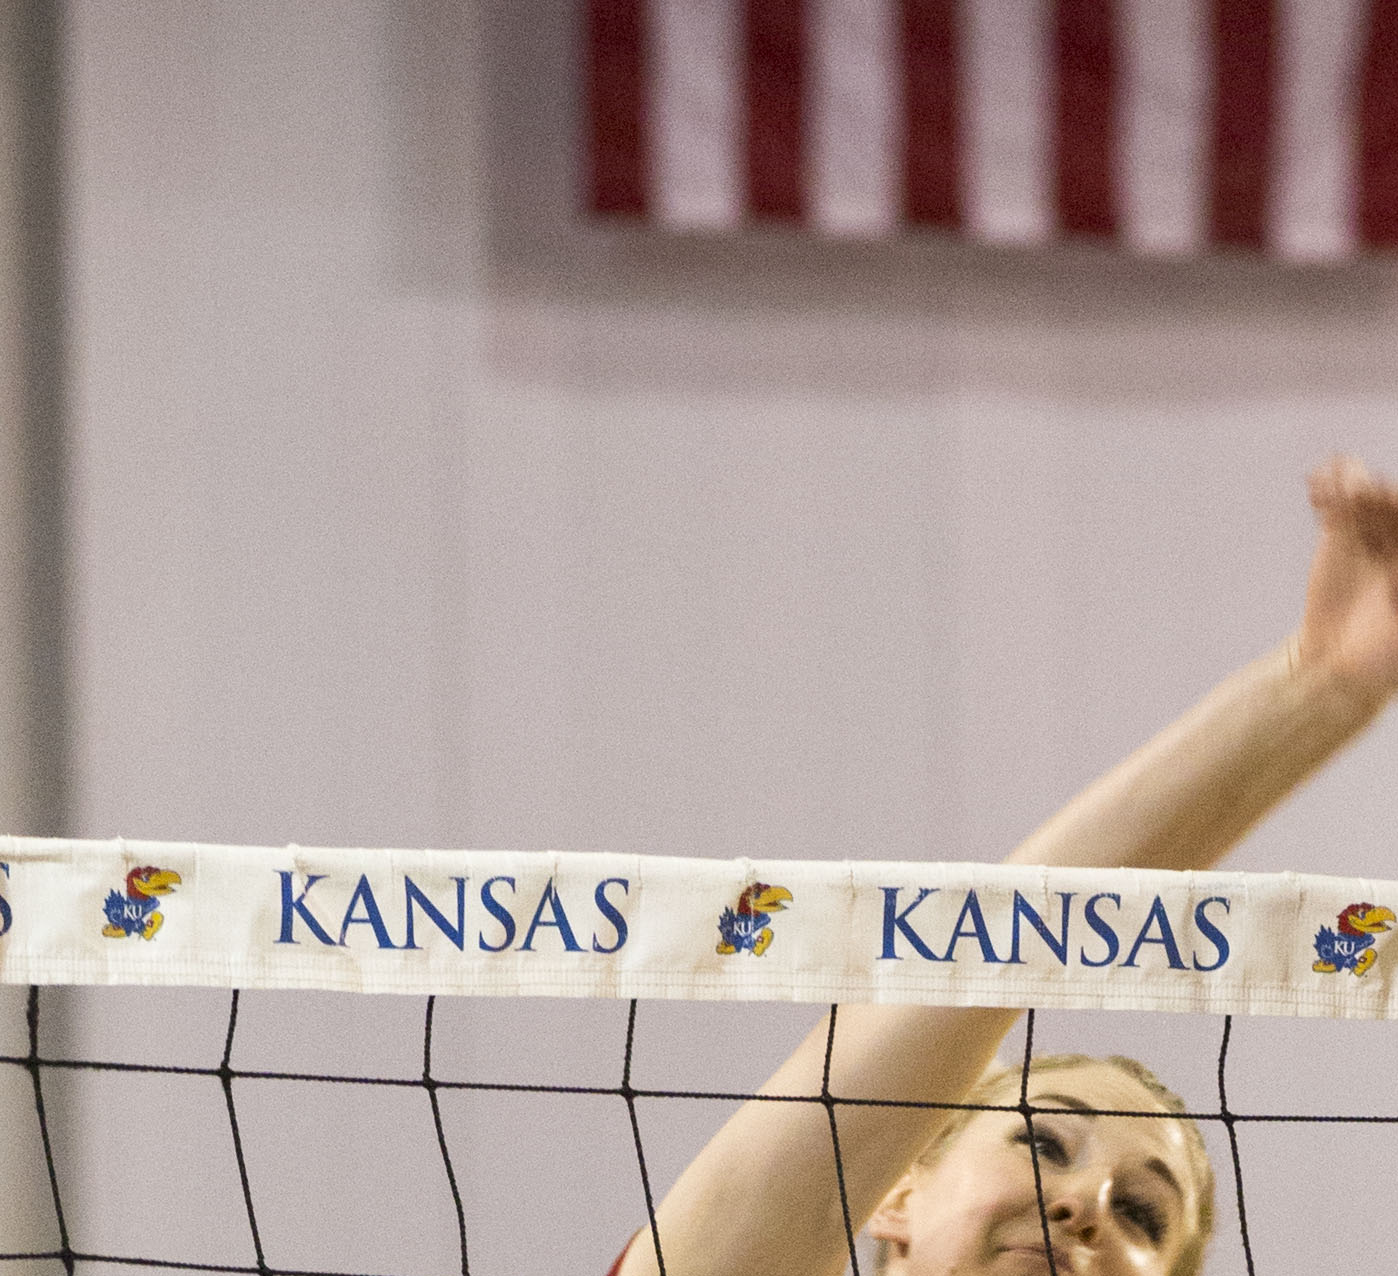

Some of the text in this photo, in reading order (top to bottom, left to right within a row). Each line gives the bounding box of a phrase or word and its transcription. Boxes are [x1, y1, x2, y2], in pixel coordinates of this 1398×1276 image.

[122, 904, 143, 920] KU
[272, 869, 630, 955] KANSAS
[876, 886, 1232, 972] KANSAS
[1334, 940, 1355, 957] KU
